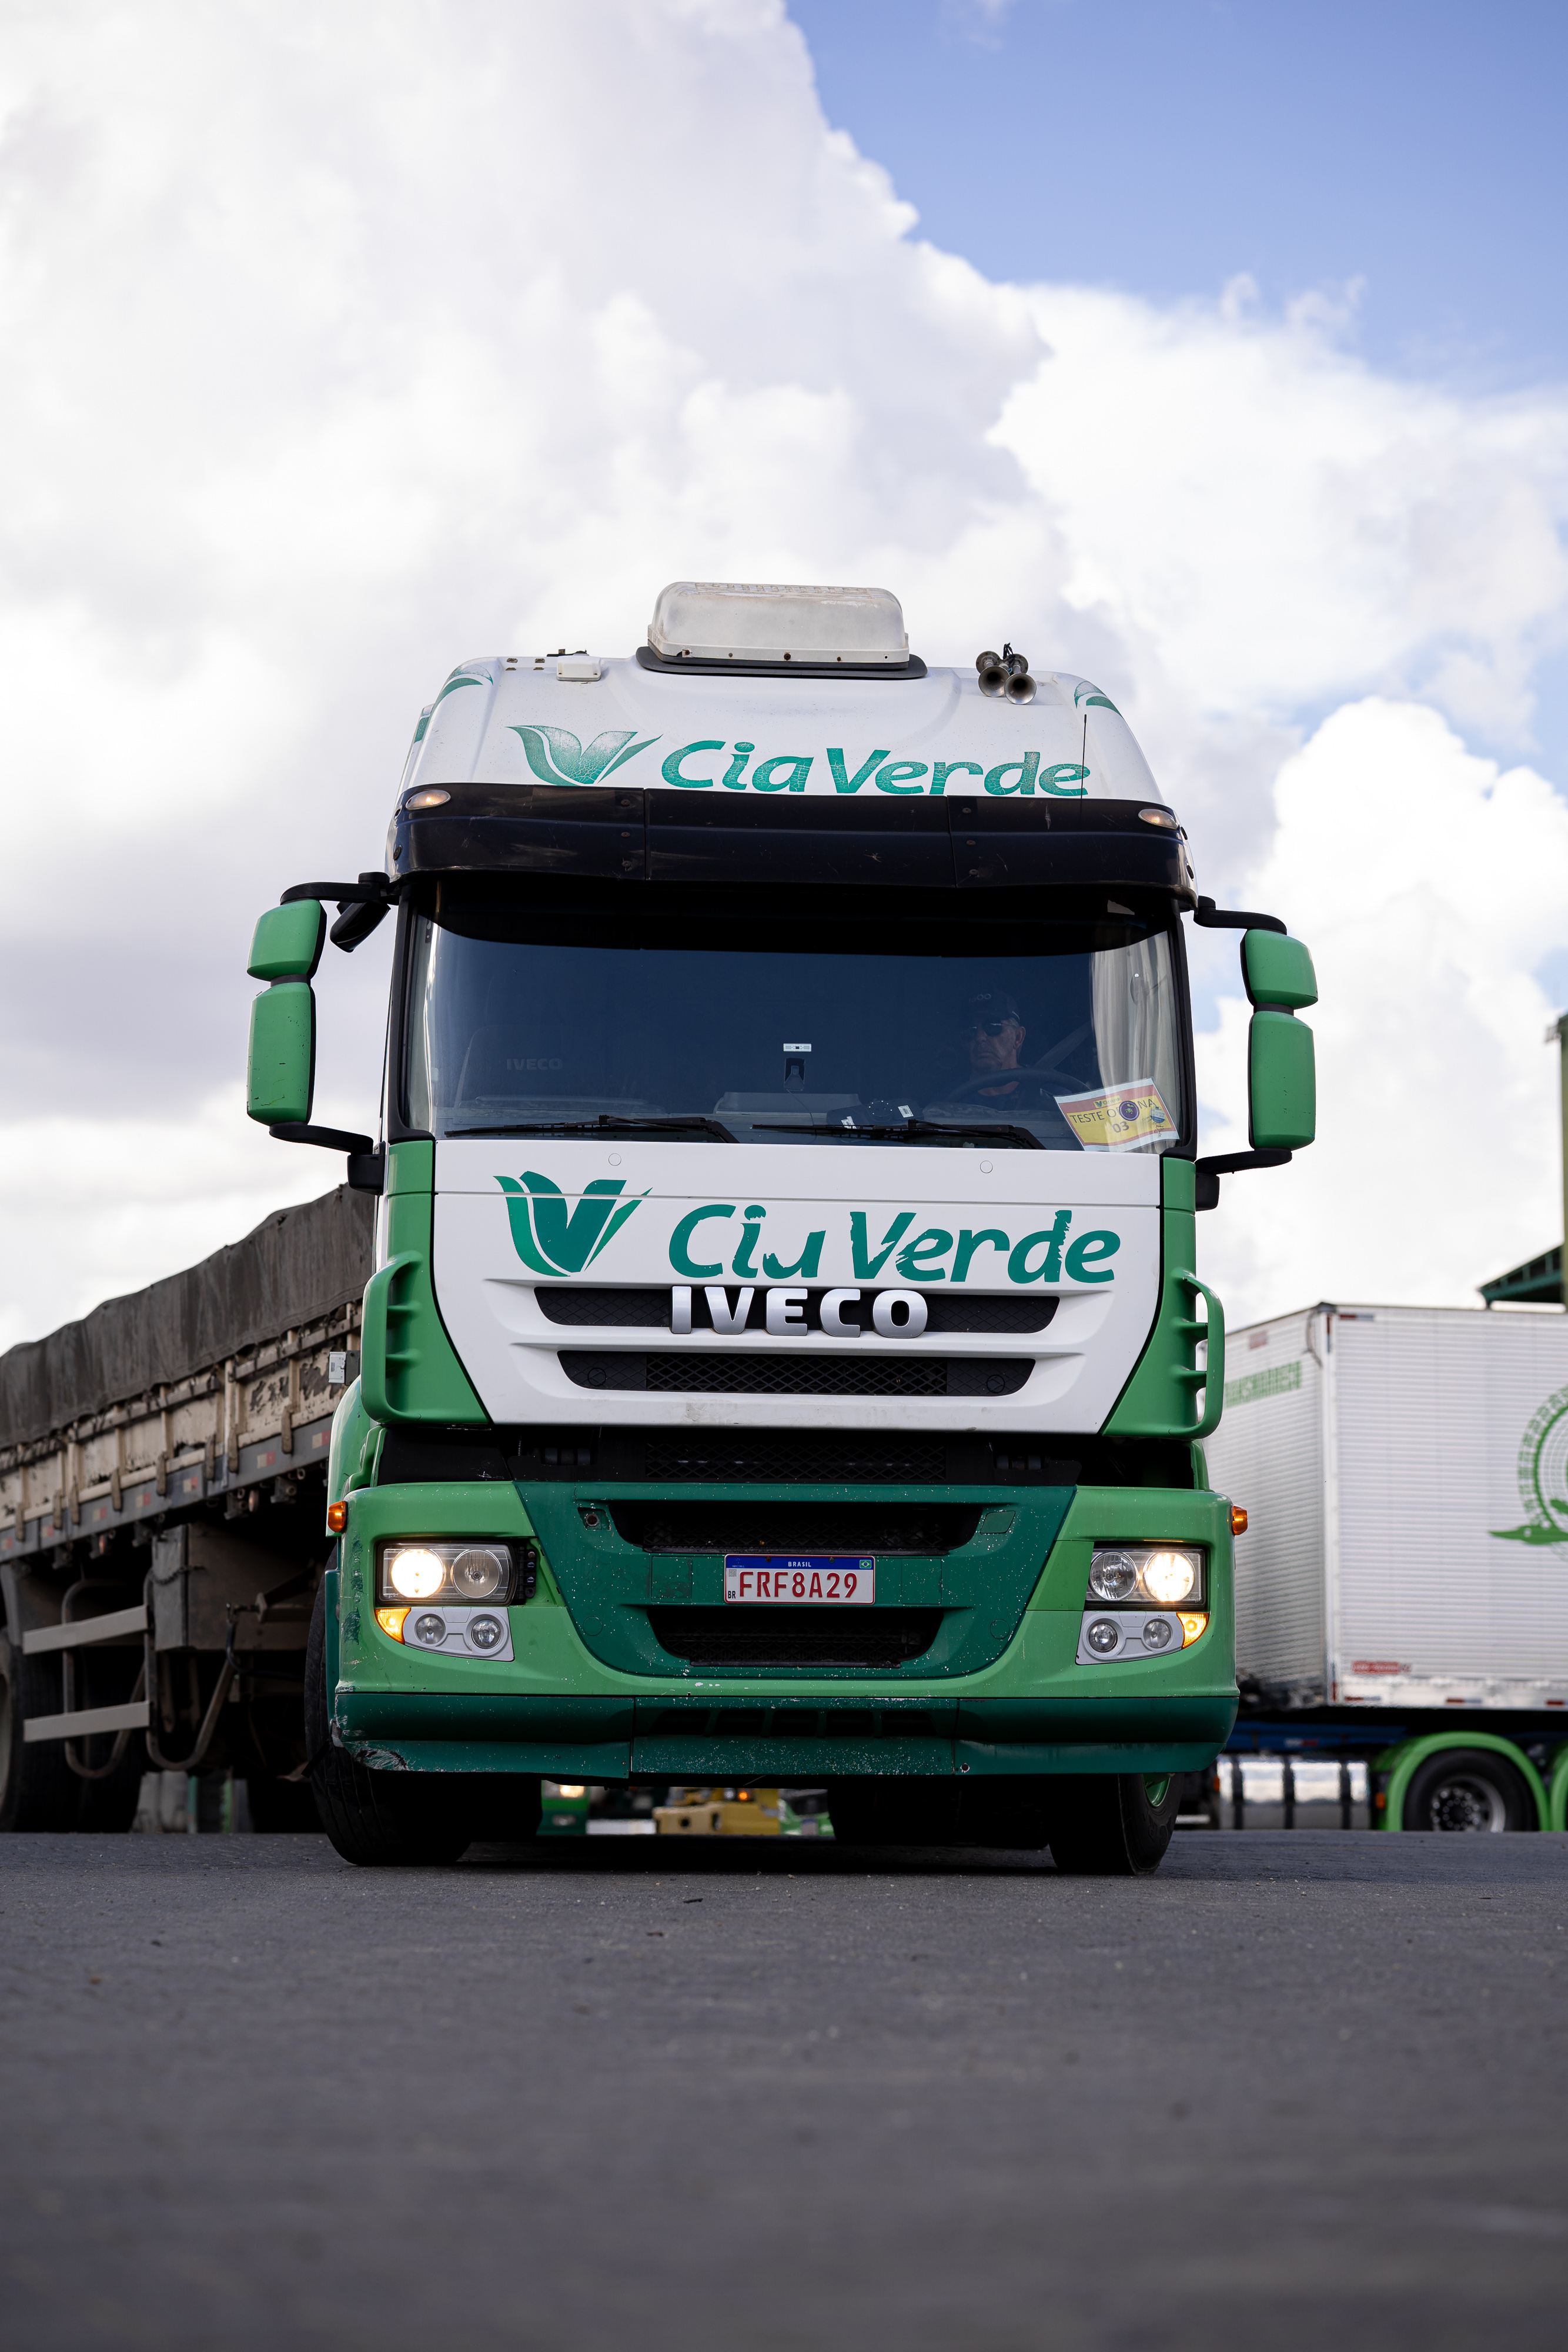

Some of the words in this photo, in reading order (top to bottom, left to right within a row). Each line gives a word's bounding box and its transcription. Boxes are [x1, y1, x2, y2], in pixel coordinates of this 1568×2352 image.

[662, 740, 814, 793] Cia
[826, 747, 1091, 797] Verde
[506, 1058, 563, 1070] IVECO
[1069, 1111, 1105, 1123] TESTE
[1112, 1121, 1129, 1133] 03
[850, 1210, 1121, 1284] Verde
[670, 1285, 928, 1339] IVECO
[728, 1591, 736, 1599] BR
[740, 1572, 857, 1598] FRF8A29
